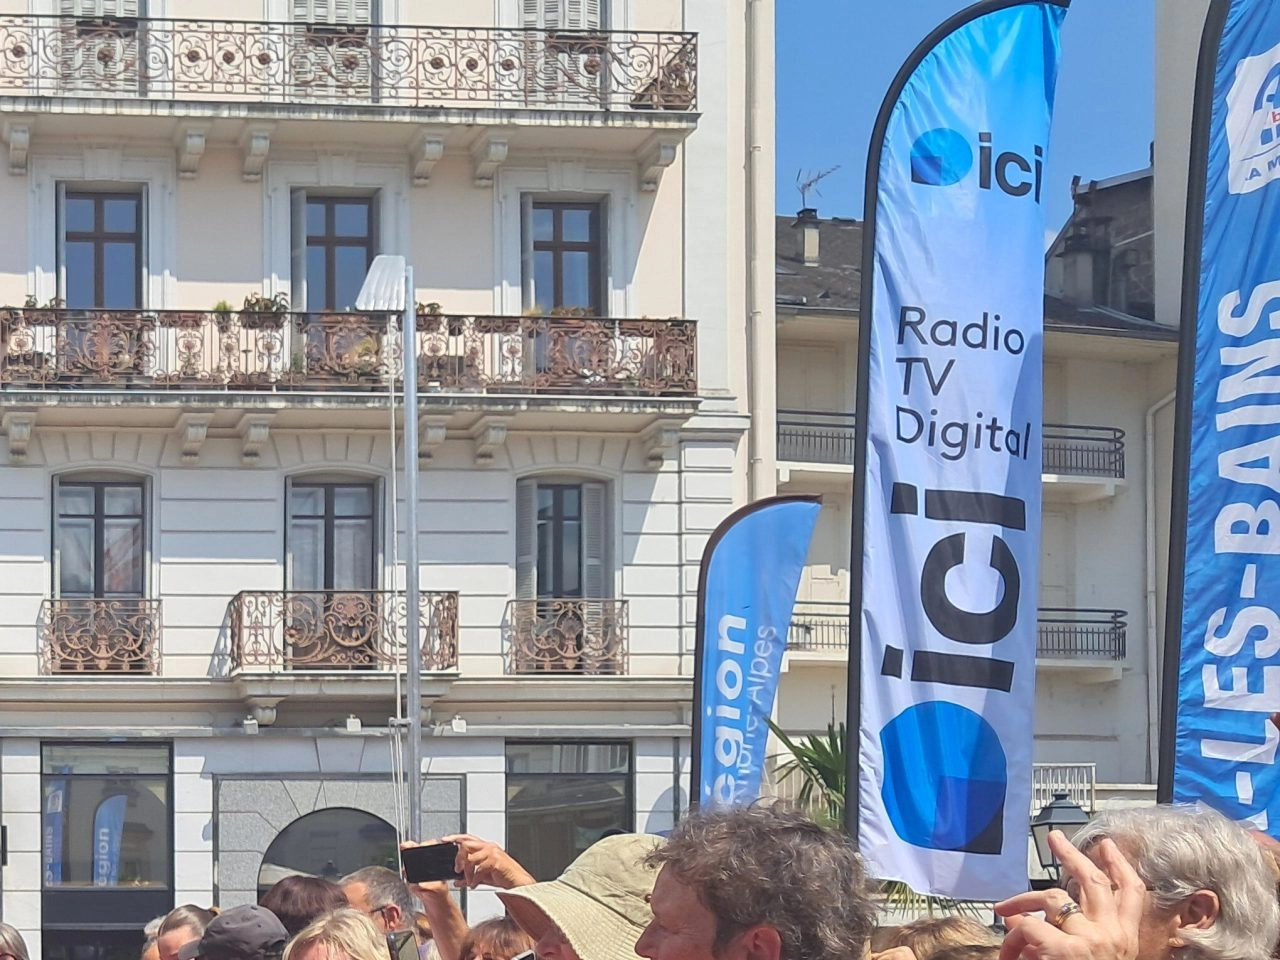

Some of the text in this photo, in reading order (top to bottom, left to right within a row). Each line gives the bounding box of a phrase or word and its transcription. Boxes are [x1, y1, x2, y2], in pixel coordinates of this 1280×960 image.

[977, 132, 1043, 205] ici
[897, 306, 1025, 356] Radio
[896, 357, 955, 396] TV
[896, 405, 1031, 461] Digital
[880, 481, 1027, 693] ici
[1201, 280, 1280, 830] -LES-BAINS
